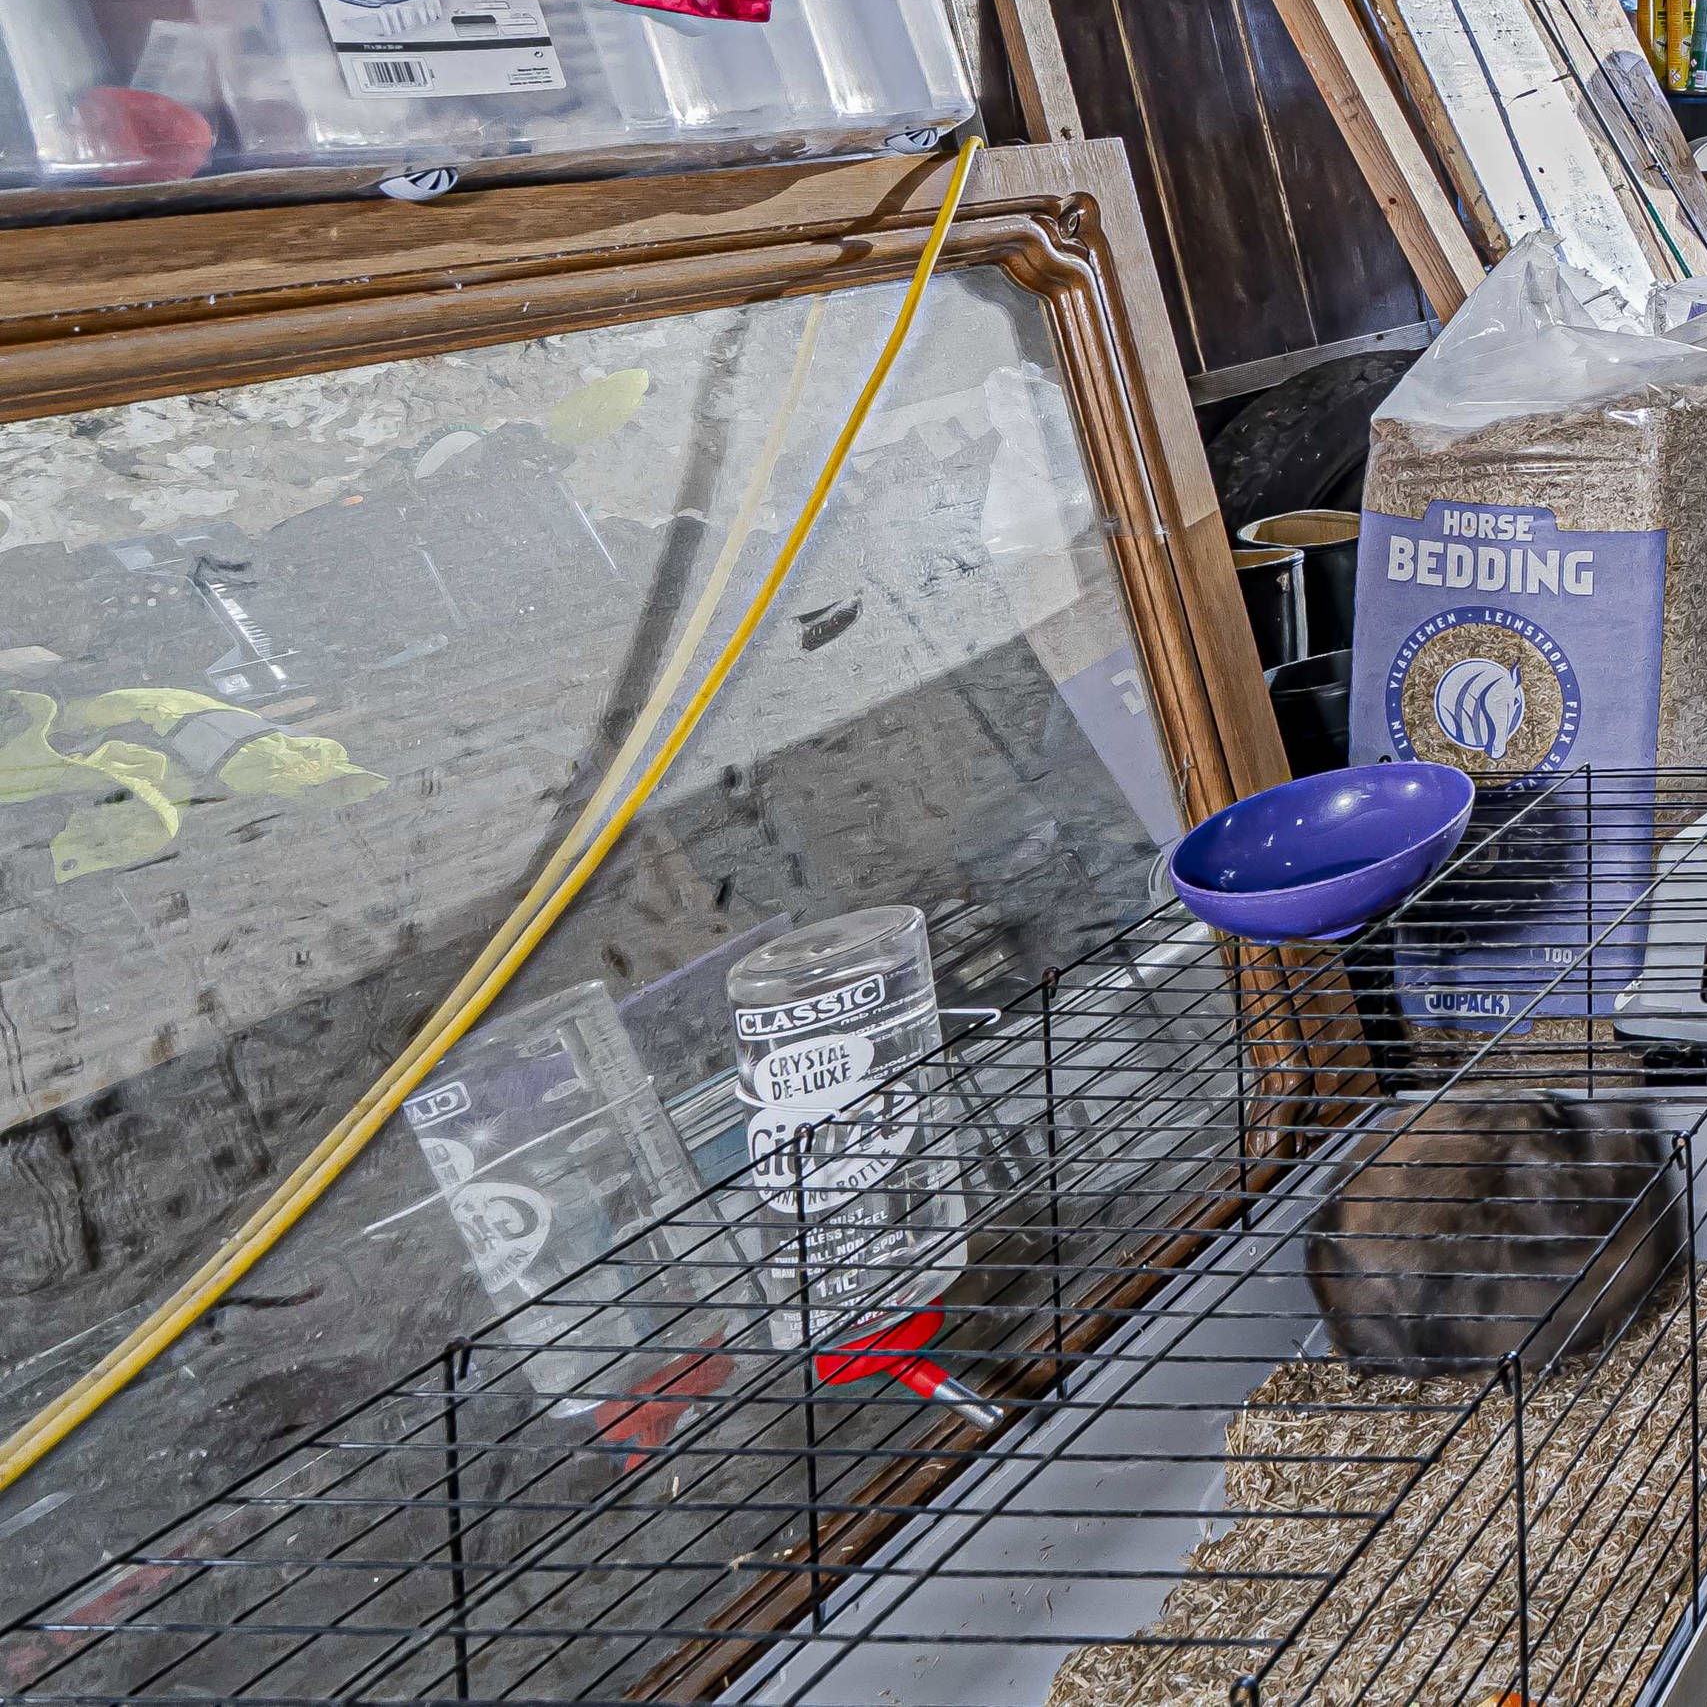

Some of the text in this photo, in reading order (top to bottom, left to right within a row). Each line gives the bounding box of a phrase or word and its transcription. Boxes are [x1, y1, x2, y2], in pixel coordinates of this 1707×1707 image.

[1443, 509, 1535, 542] HORSE
[1387, 535, 1594, 596] BEDDING
[1389, 612, 1457, 689] VLASLEMEN
[1484, 609, 1569, 674] LEINSTROH
[1389, 720, 1409, 750] LIN
[1558, 701, 1578, 744] FLAX
[739, 980, 879, 1035] CLASSIC
[769, 1041, 850, 1079] CRYSTAL
[771, 1060, 852, 1102] DE-LUXE
